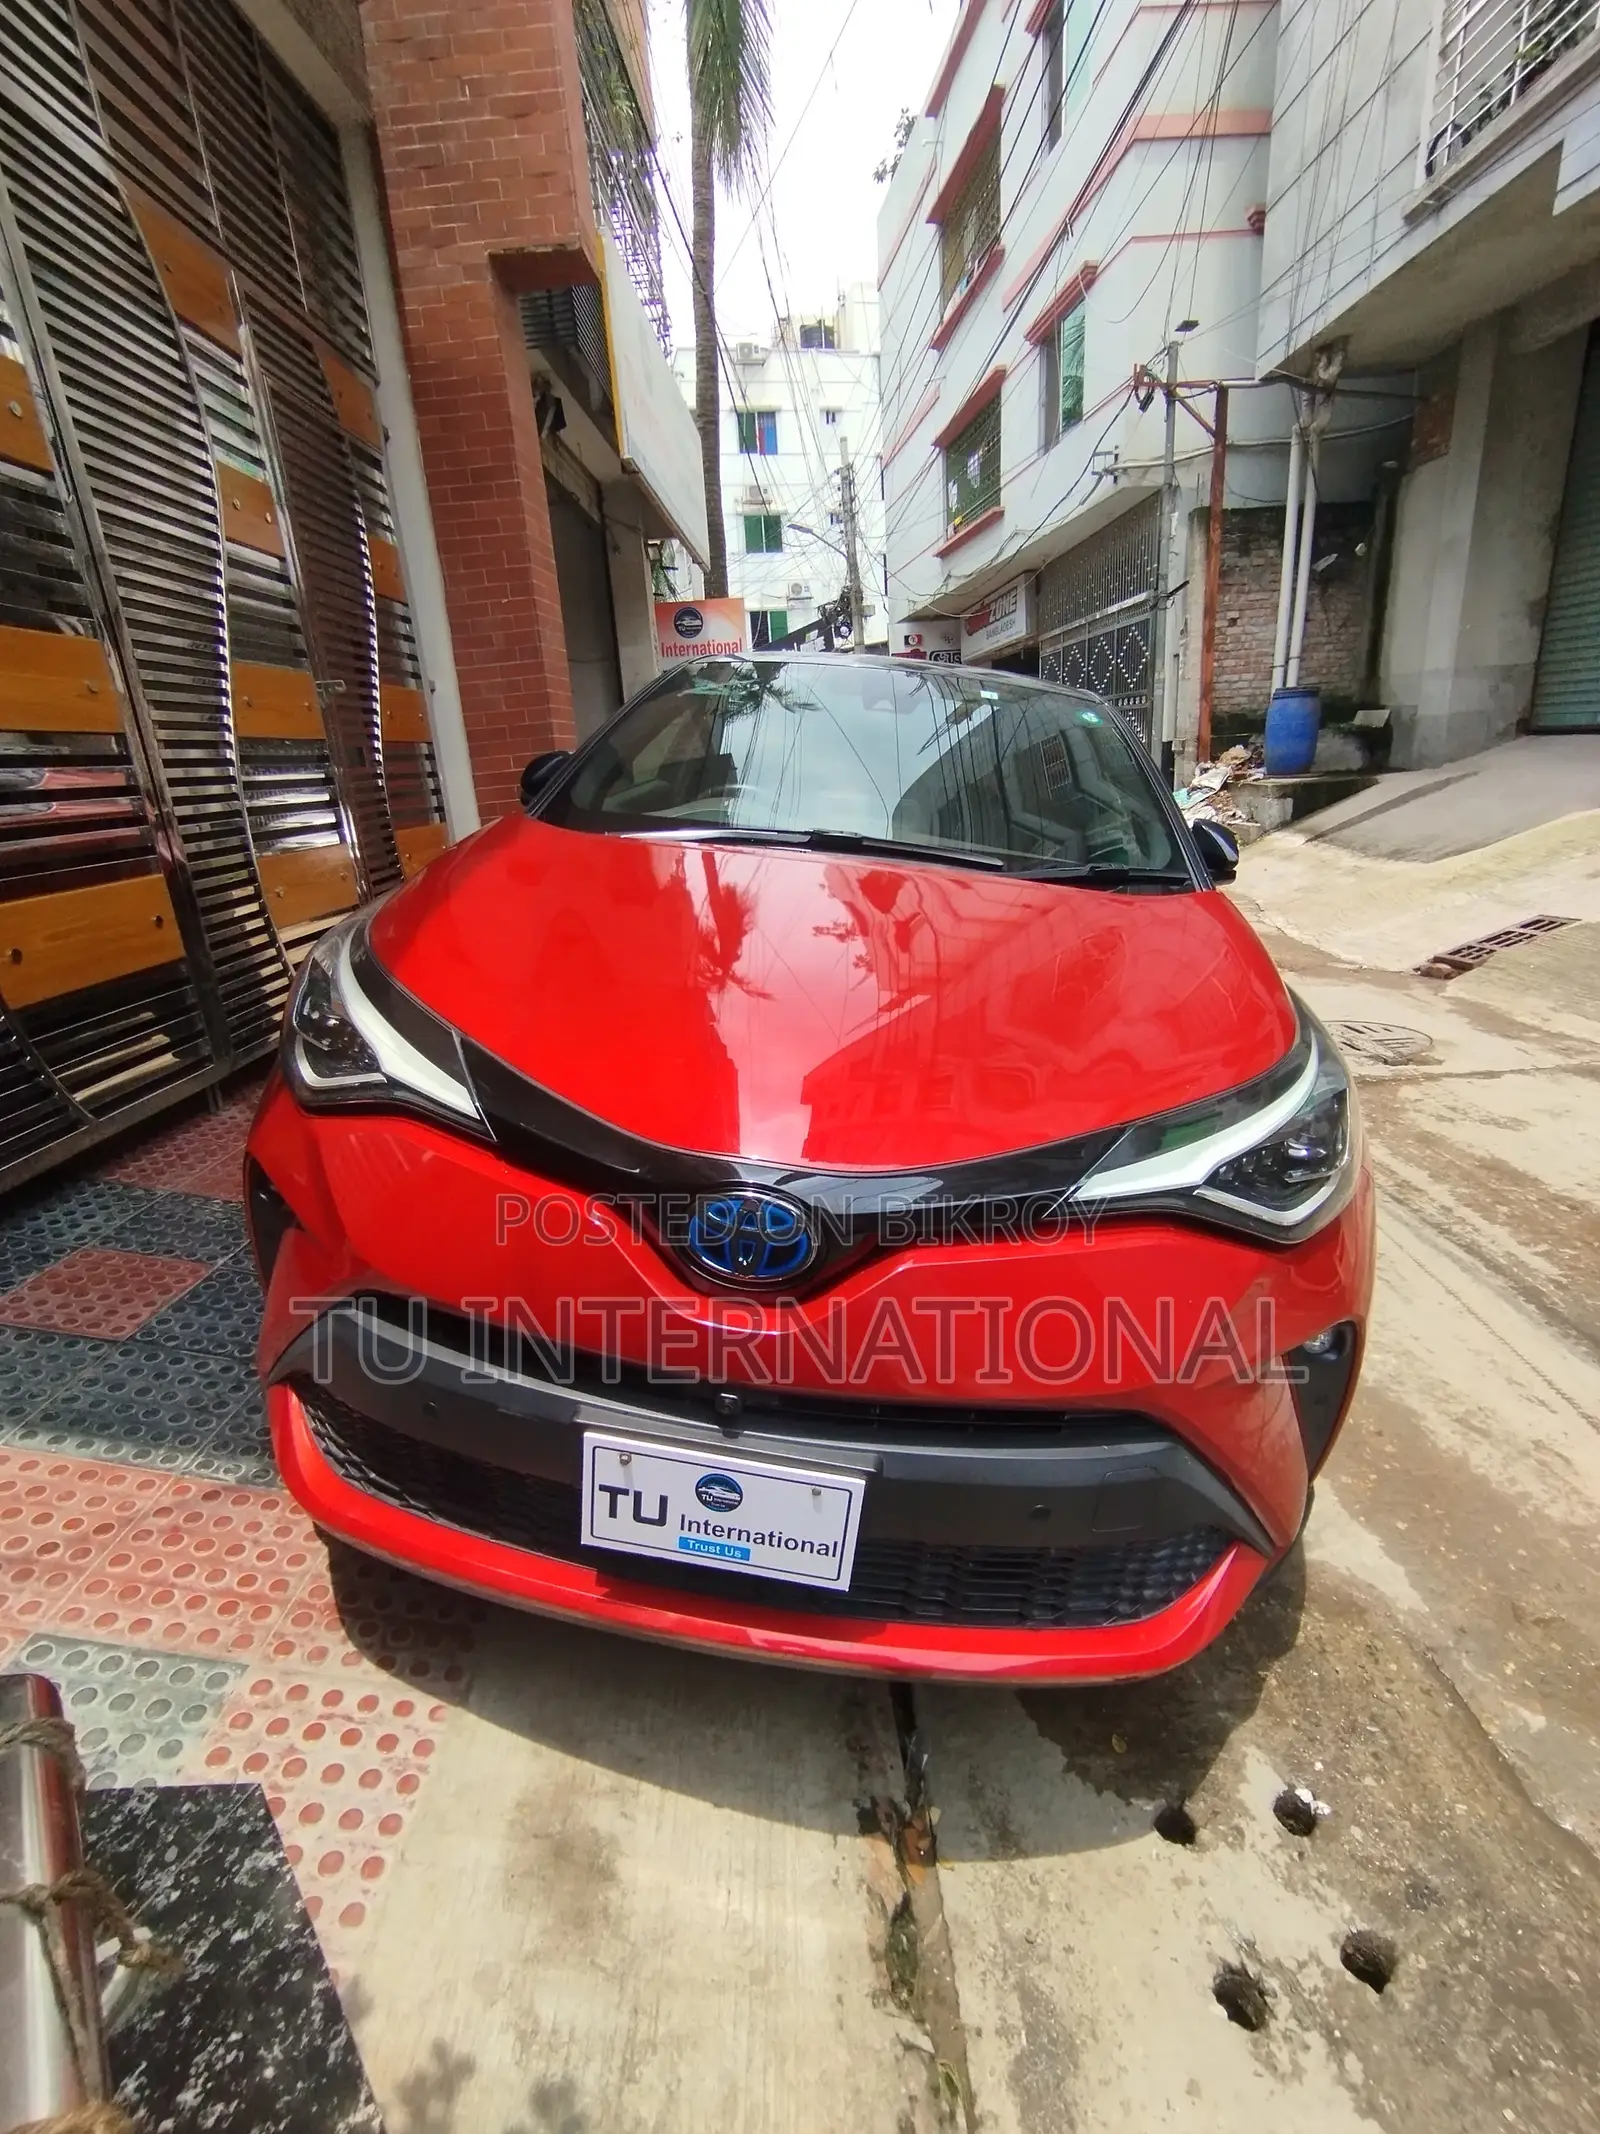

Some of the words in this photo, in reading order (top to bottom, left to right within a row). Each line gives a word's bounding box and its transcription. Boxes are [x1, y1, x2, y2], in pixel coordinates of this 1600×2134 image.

[988, 586, 1018, 624] ZONE
[985, 618, 1016, 640] BANGLADESH
[661, 637, 743, 658] International
[598, 1484, 669, 1527] TU
[679, 1514, 839, 1558] International
[687, 1539, 721, 1554] Trust
[724, 1546, 742, 1559] Us
